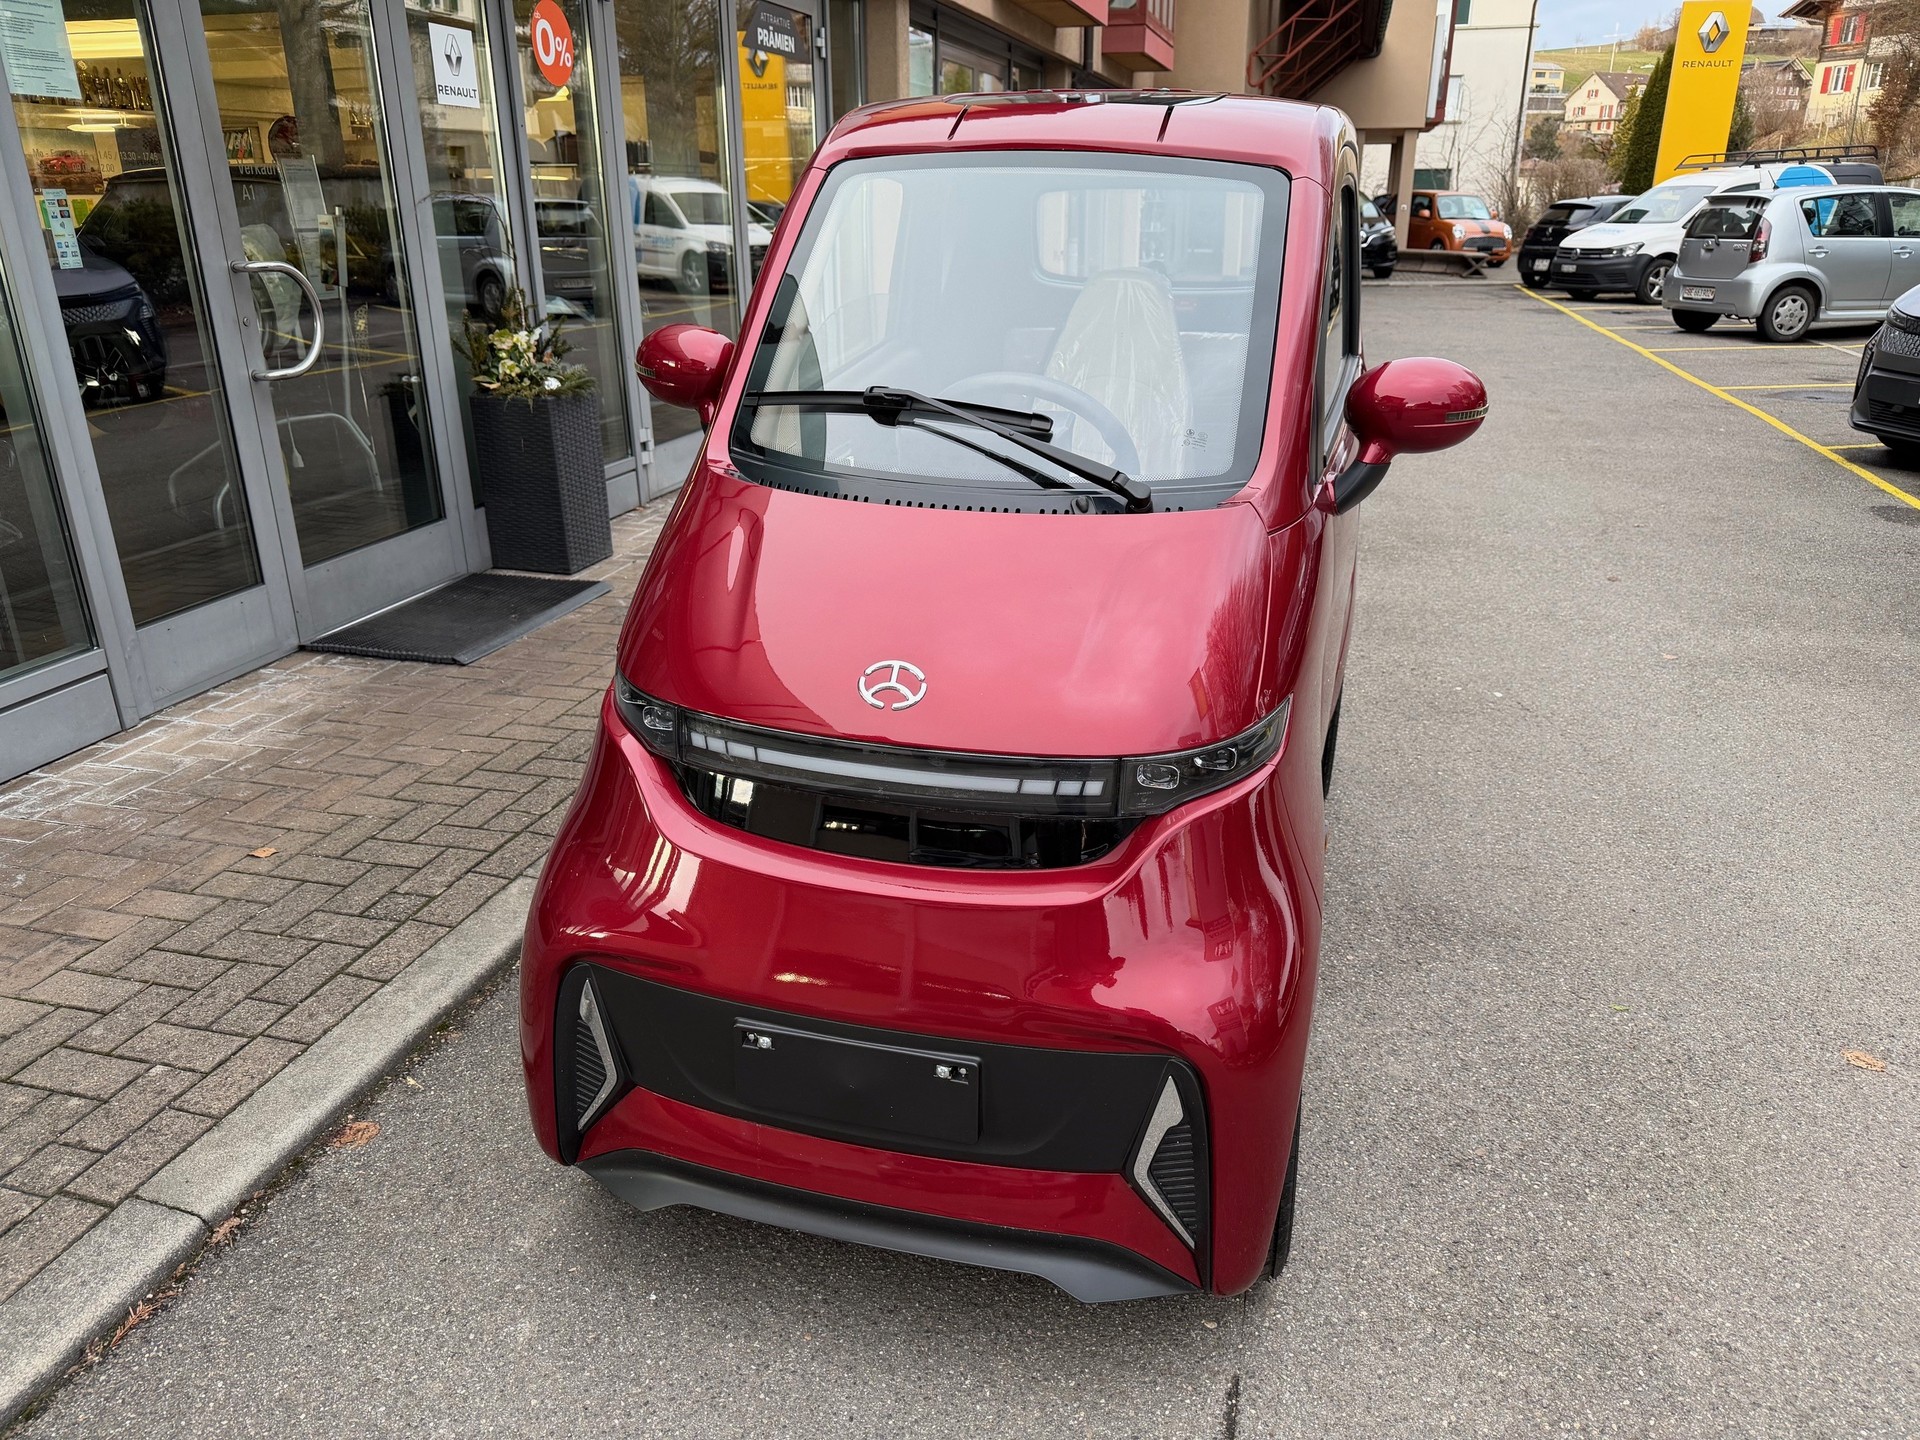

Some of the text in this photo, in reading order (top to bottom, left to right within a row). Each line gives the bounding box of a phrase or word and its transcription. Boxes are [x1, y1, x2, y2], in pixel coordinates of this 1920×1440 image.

[760, 12, 791, 29] ATTRAKTIVE
[535, 18, 572, 68] 0%
[757, 26, 796, 54] PRÄMIEN
[1682, 60, 1734, 68] RENAULT
[437, 84, 477, 99] RENAULT
